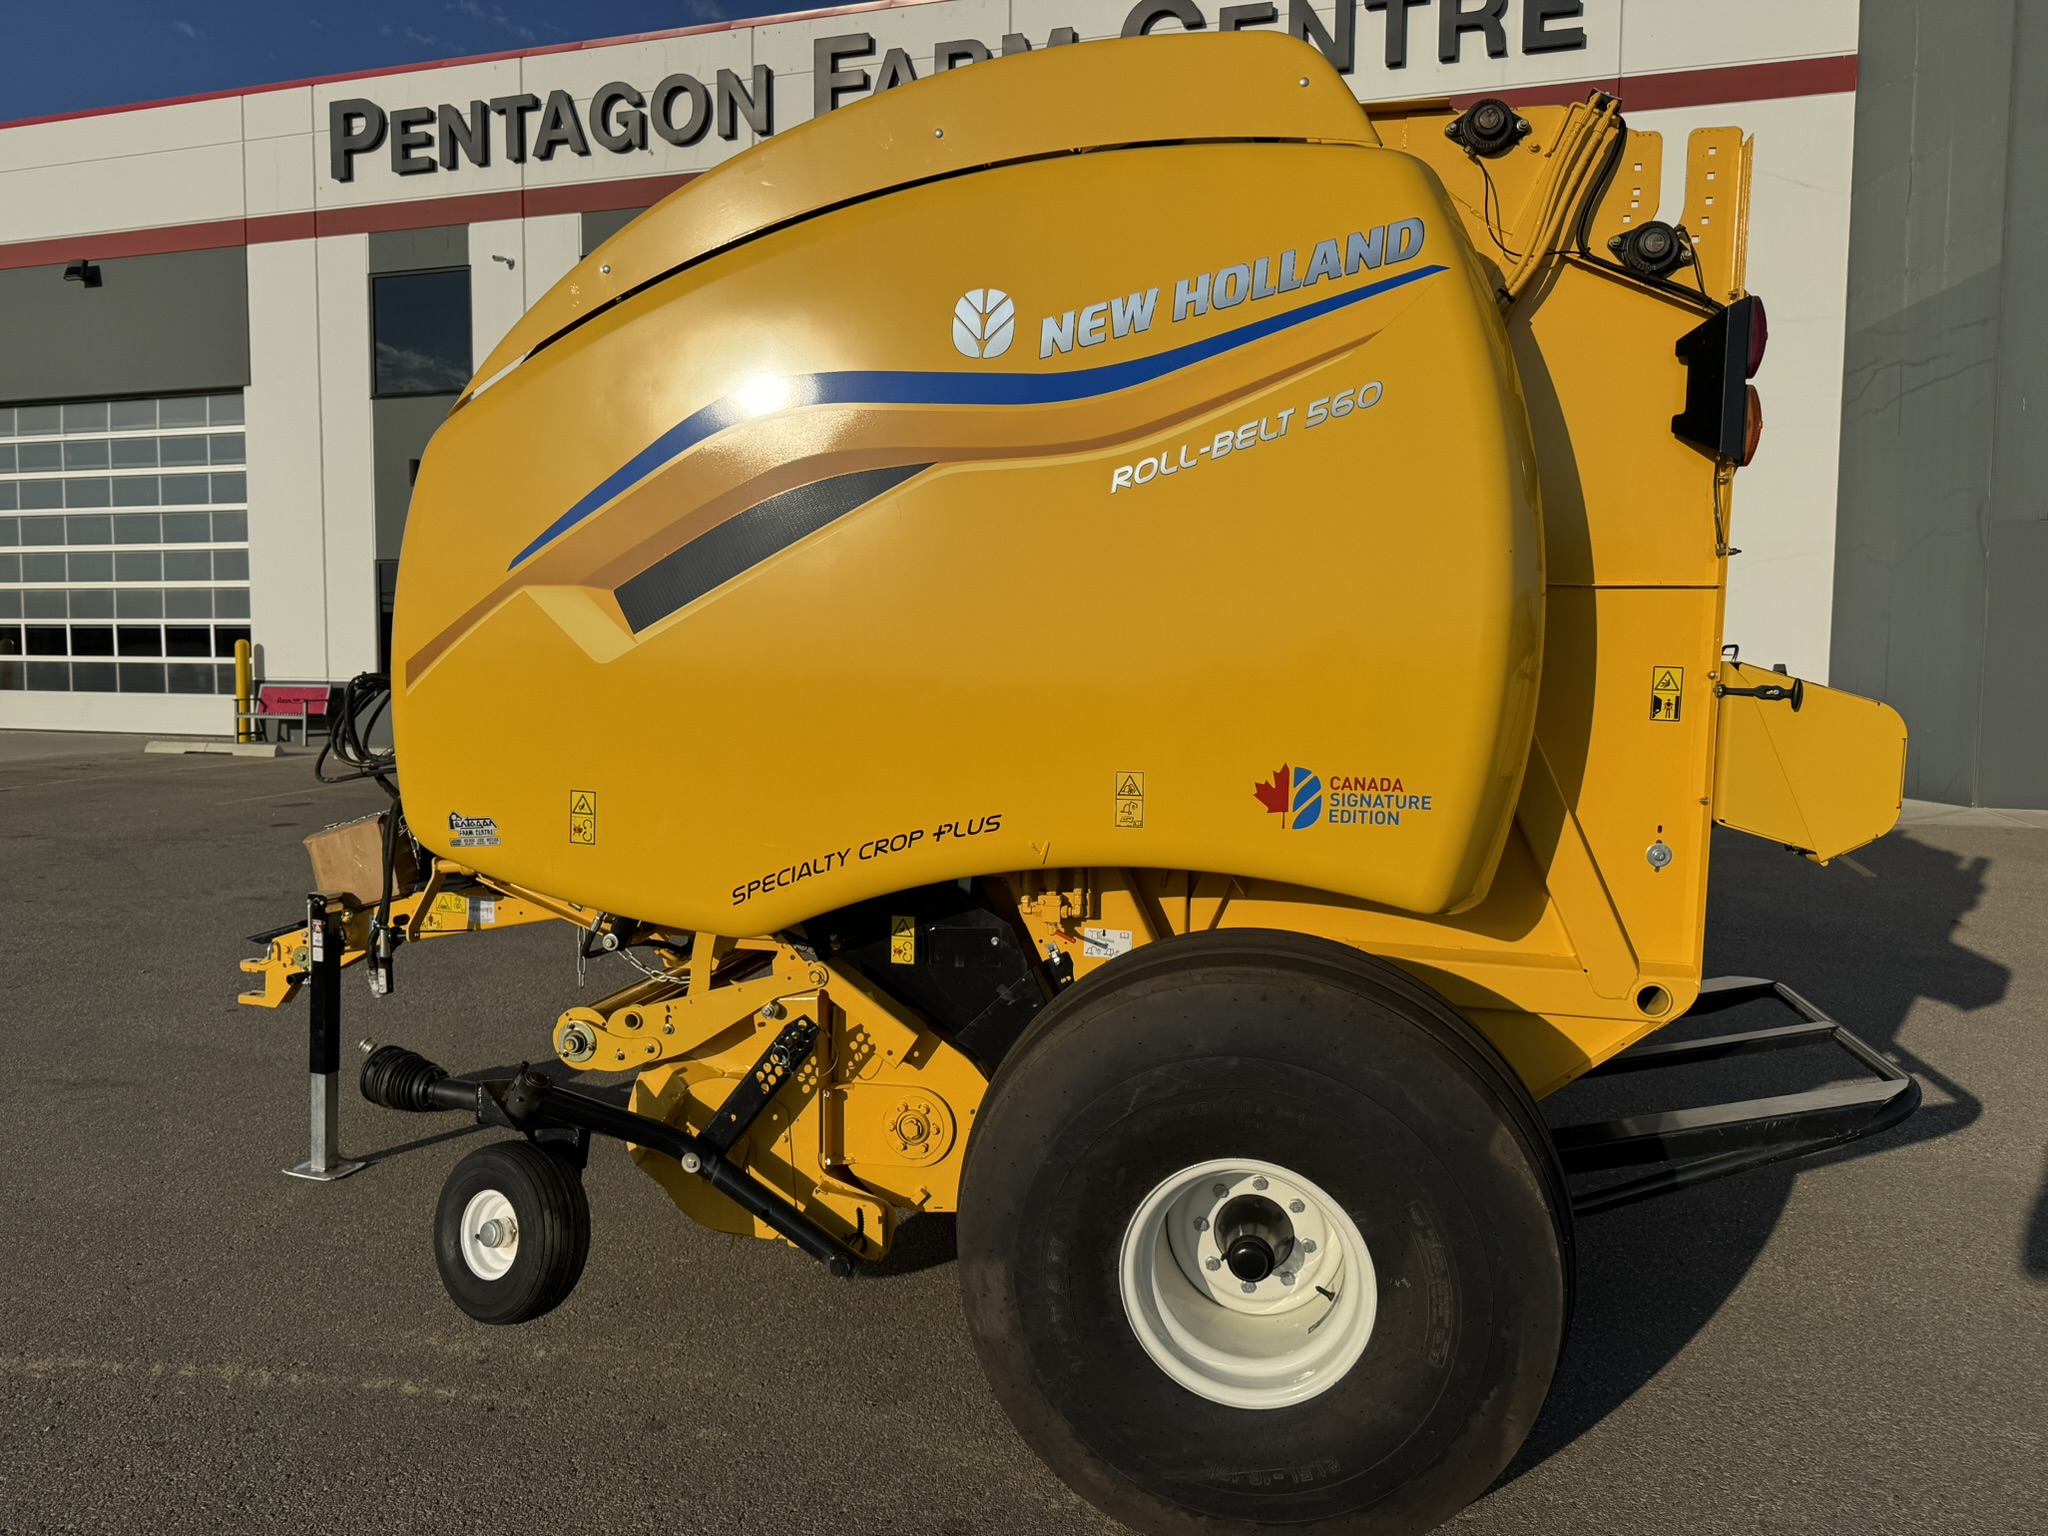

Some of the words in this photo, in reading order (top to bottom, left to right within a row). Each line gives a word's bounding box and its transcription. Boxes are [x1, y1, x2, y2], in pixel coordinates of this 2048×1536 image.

[330, 64, 772, 182] PENTAGON
[814, 27, 1080, 118] FA
[1039, 287, 1159, 360] NEW
[1172, 216, 1425, 323] HOLLAND
[1110, 407, 1296, 494] ROLL-BELT
[1304, 381, 1384, 429] 560
[1328, 810, 1400, 826] EDITION
[1329, 776, 1404, 792] CANADA
[1329, 793, 1432, 811] SIGNATURE
[732, 848, 851, 906] SPECIALTY
[858, 829, 924, 860] CROP
[932, 814, 1002, 842] PLUS
